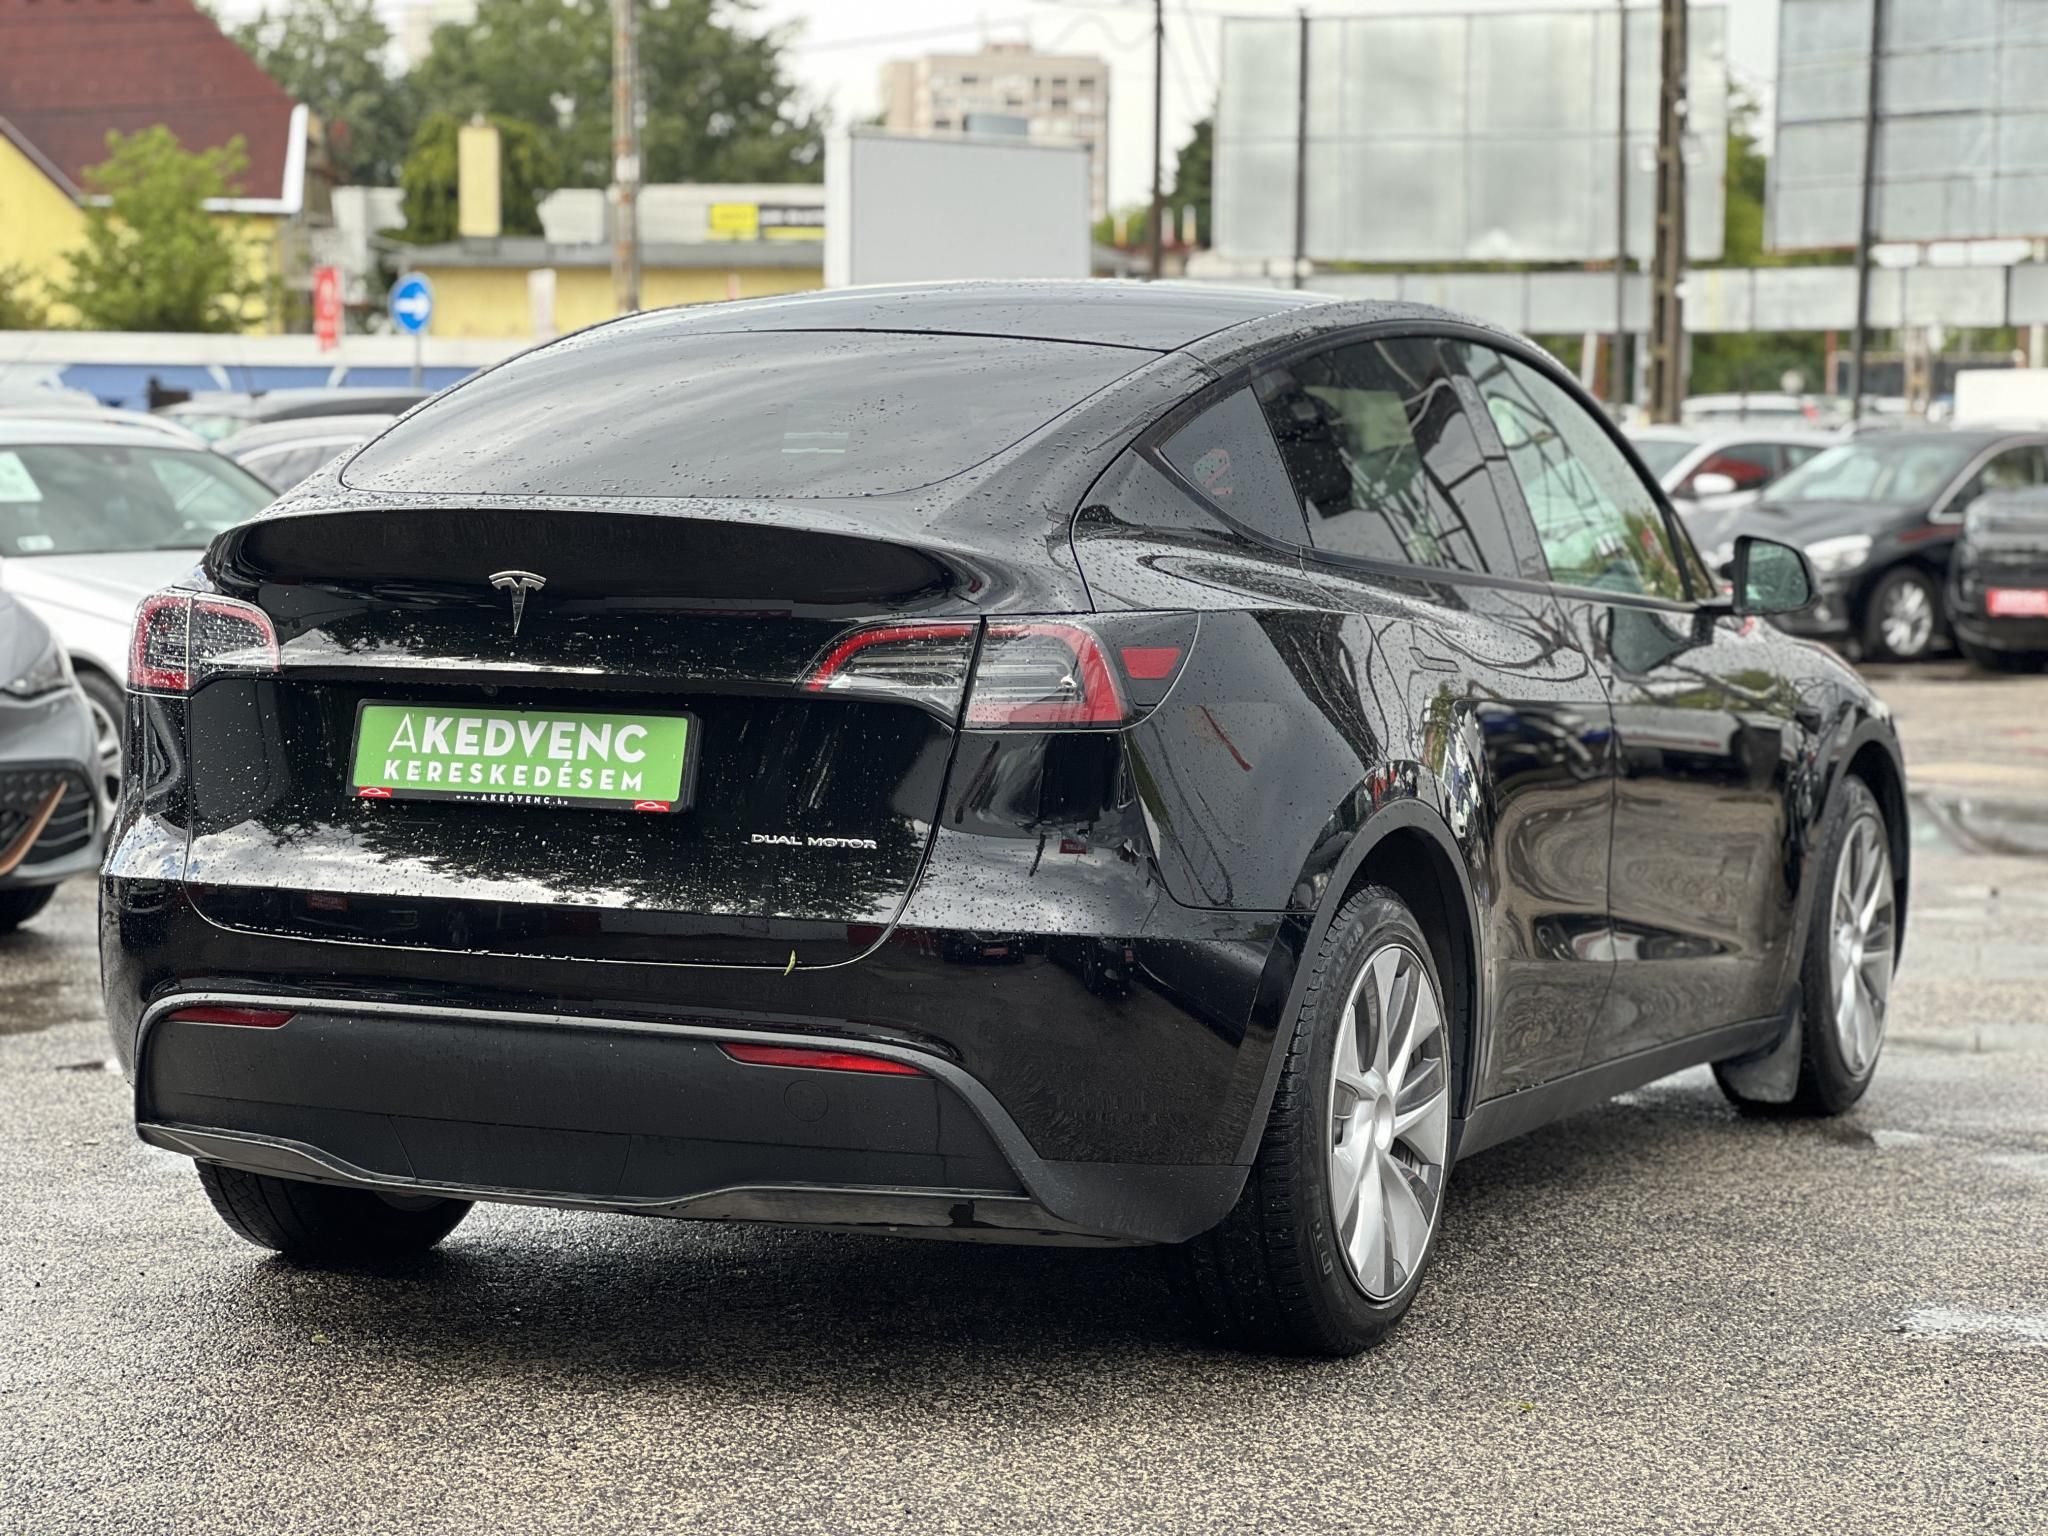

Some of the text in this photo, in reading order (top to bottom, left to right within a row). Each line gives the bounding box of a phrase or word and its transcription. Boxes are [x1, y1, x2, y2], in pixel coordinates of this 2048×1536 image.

[383, 759, 643, 792] KERESKEDÉSEM
[455, 793, 569, 806] www.AKEDVENC.hu
[751, 834, 878, 850] DUAL MOTOR
